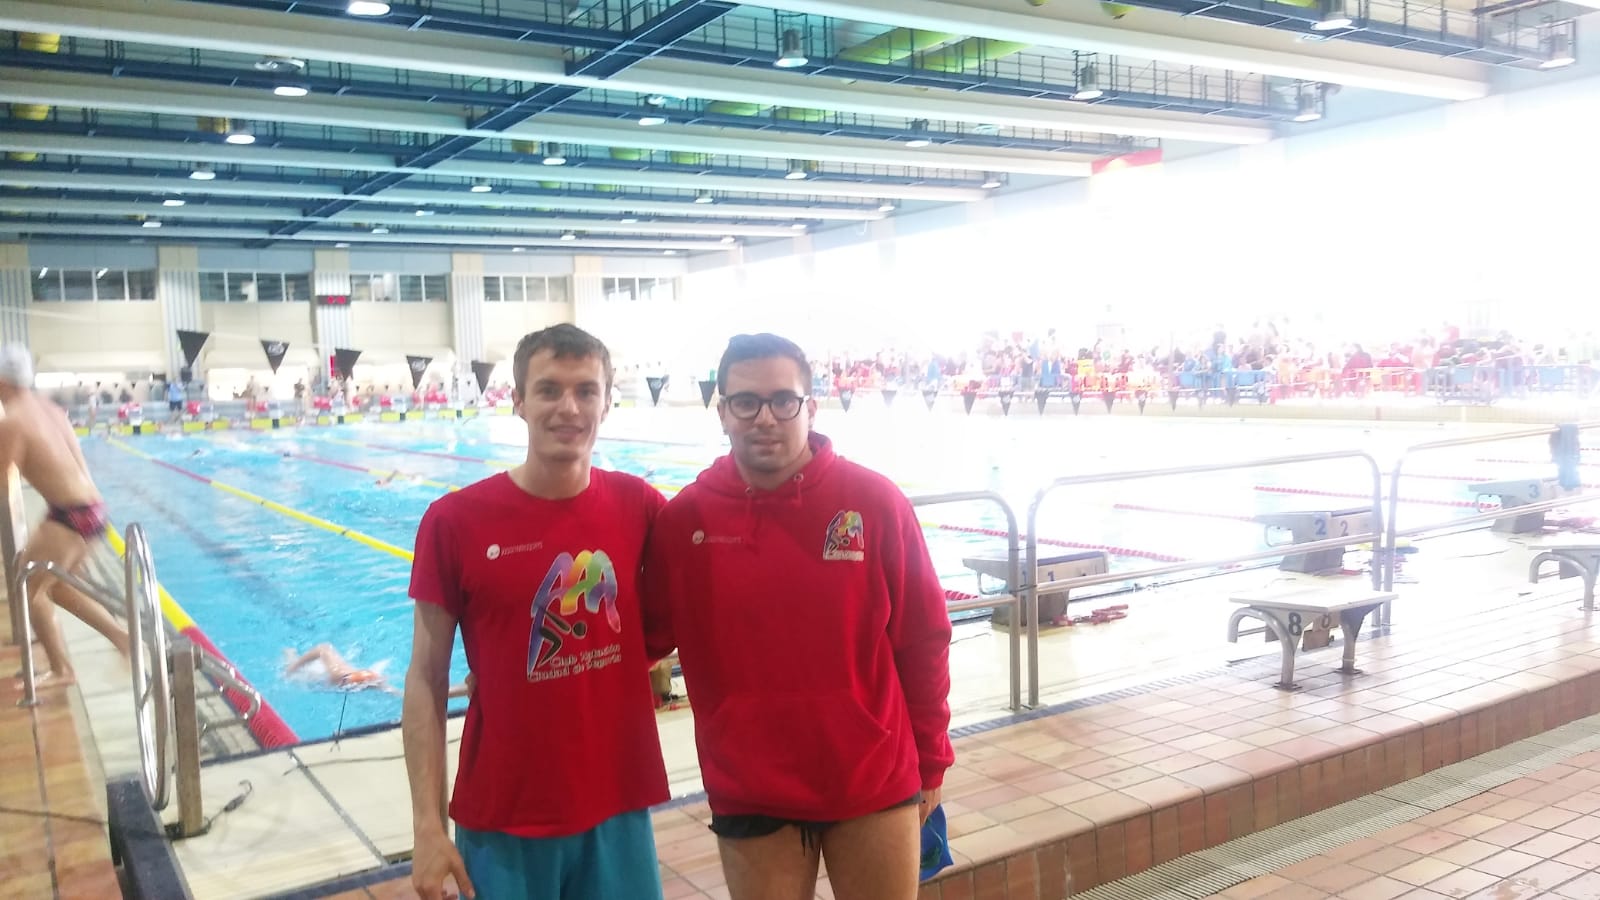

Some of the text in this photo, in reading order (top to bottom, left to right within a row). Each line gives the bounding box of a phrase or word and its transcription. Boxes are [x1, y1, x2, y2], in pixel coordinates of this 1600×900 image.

[1314, 519, 1326, 535] 2
[1340, 520, 1349, 536] 2
[1048, 571, 1055, 581] 1
[1289, 612, 1302, 636] 8
